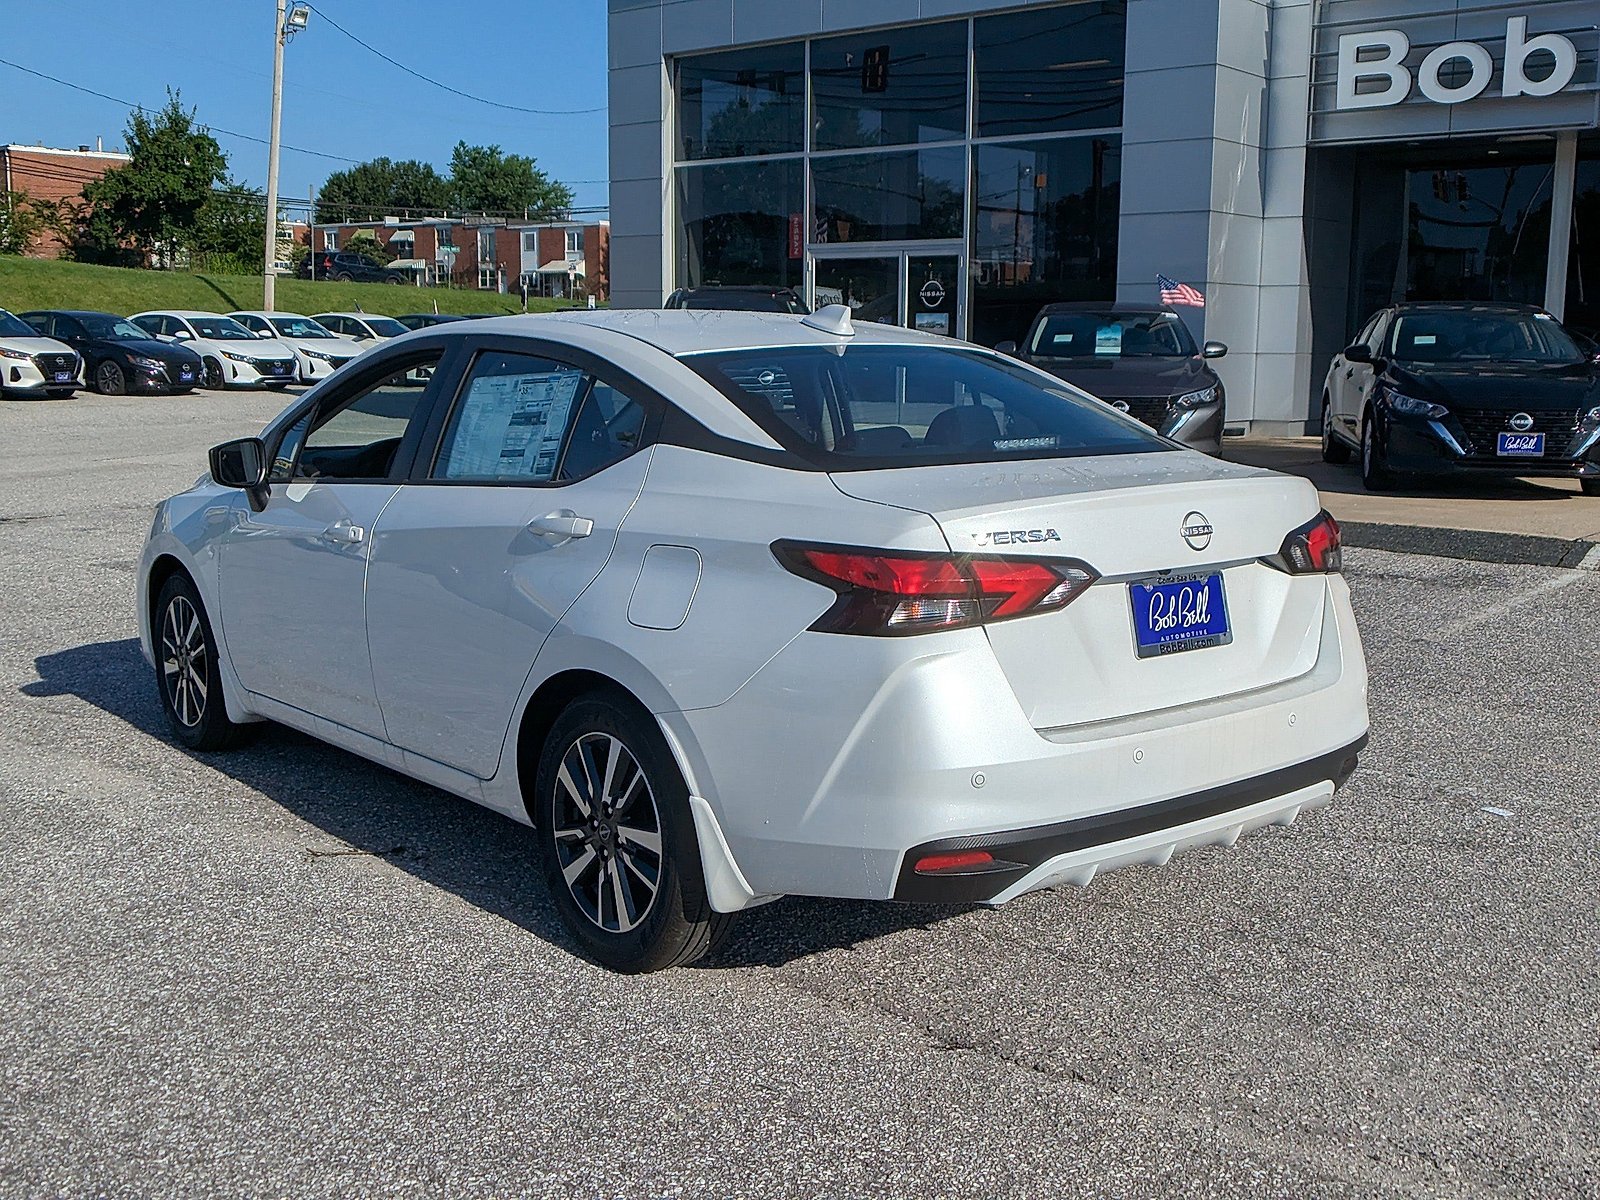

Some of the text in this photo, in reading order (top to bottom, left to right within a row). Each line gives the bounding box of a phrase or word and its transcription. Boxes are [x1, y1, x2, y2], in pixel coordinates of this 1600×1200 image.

[1337, 16, 1577, 109] Bob
[1504, 436, 1537, 449] Bob Bell
[972, 528, 1061, 546] VERSA
[1181, 525, 1213, 537] NISSAN
[1149, 585, 1211, 631] Bob Bell
[1160, 629, 1208, 641] AUTOMOTIVE
[1159, 638, 1214, 654] BobBell.com
